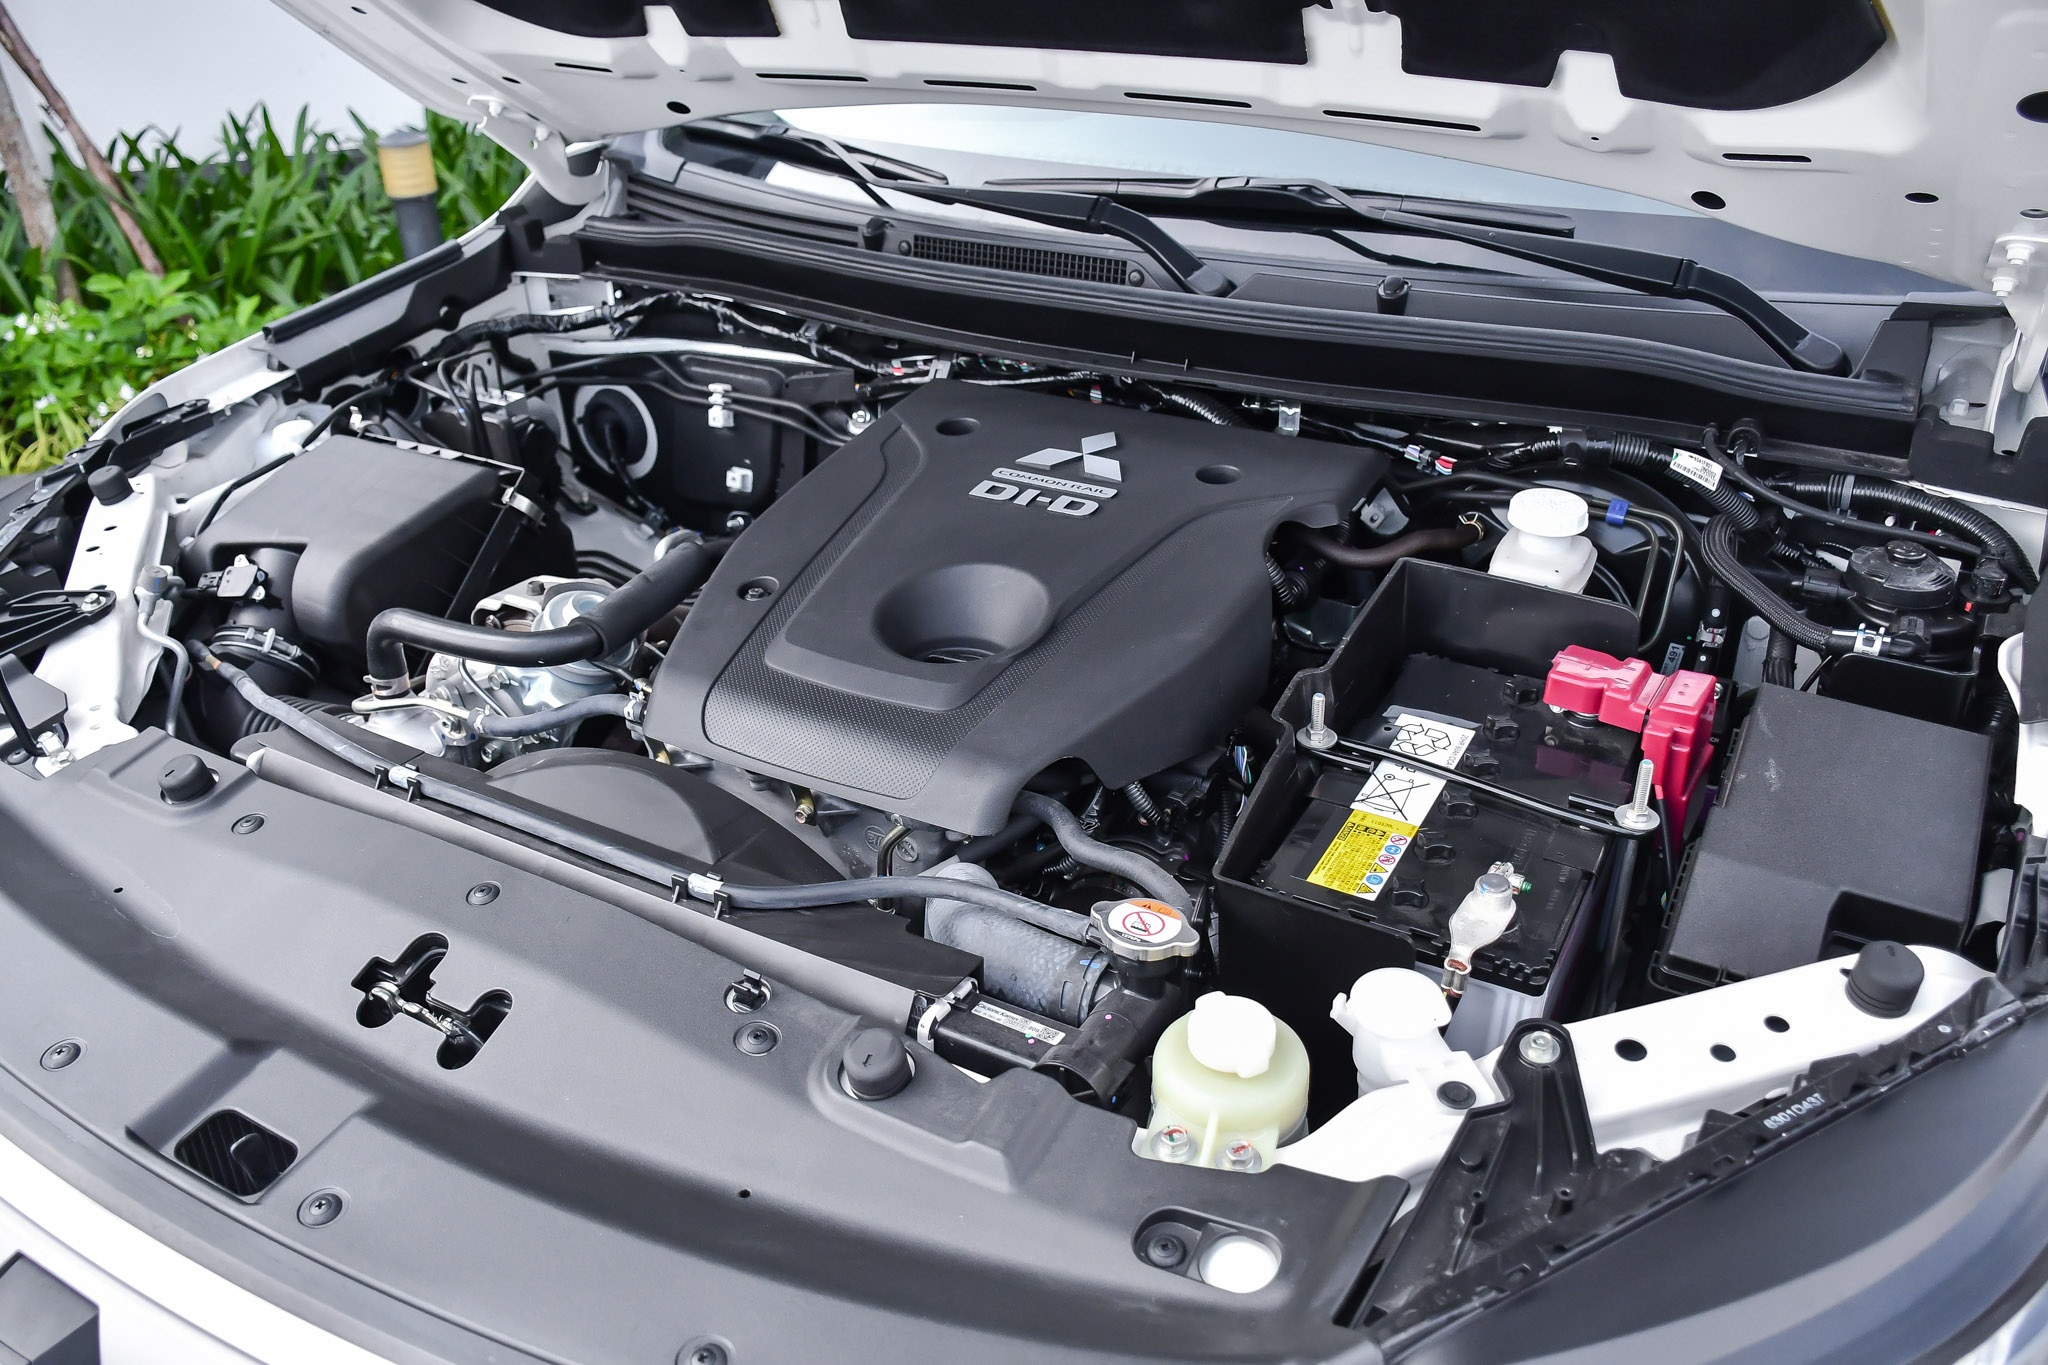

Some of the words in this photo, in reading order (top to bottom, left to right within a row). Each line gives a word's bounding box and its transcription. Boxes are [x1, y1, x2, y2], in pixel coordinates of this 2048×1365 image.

[998, 470, 1067, 487] COMMON
[1069, 484, 1109, 496] RAIL
[968, 479, 1099, 516] DI-D
[1668, 645, 1680, 662] 491
